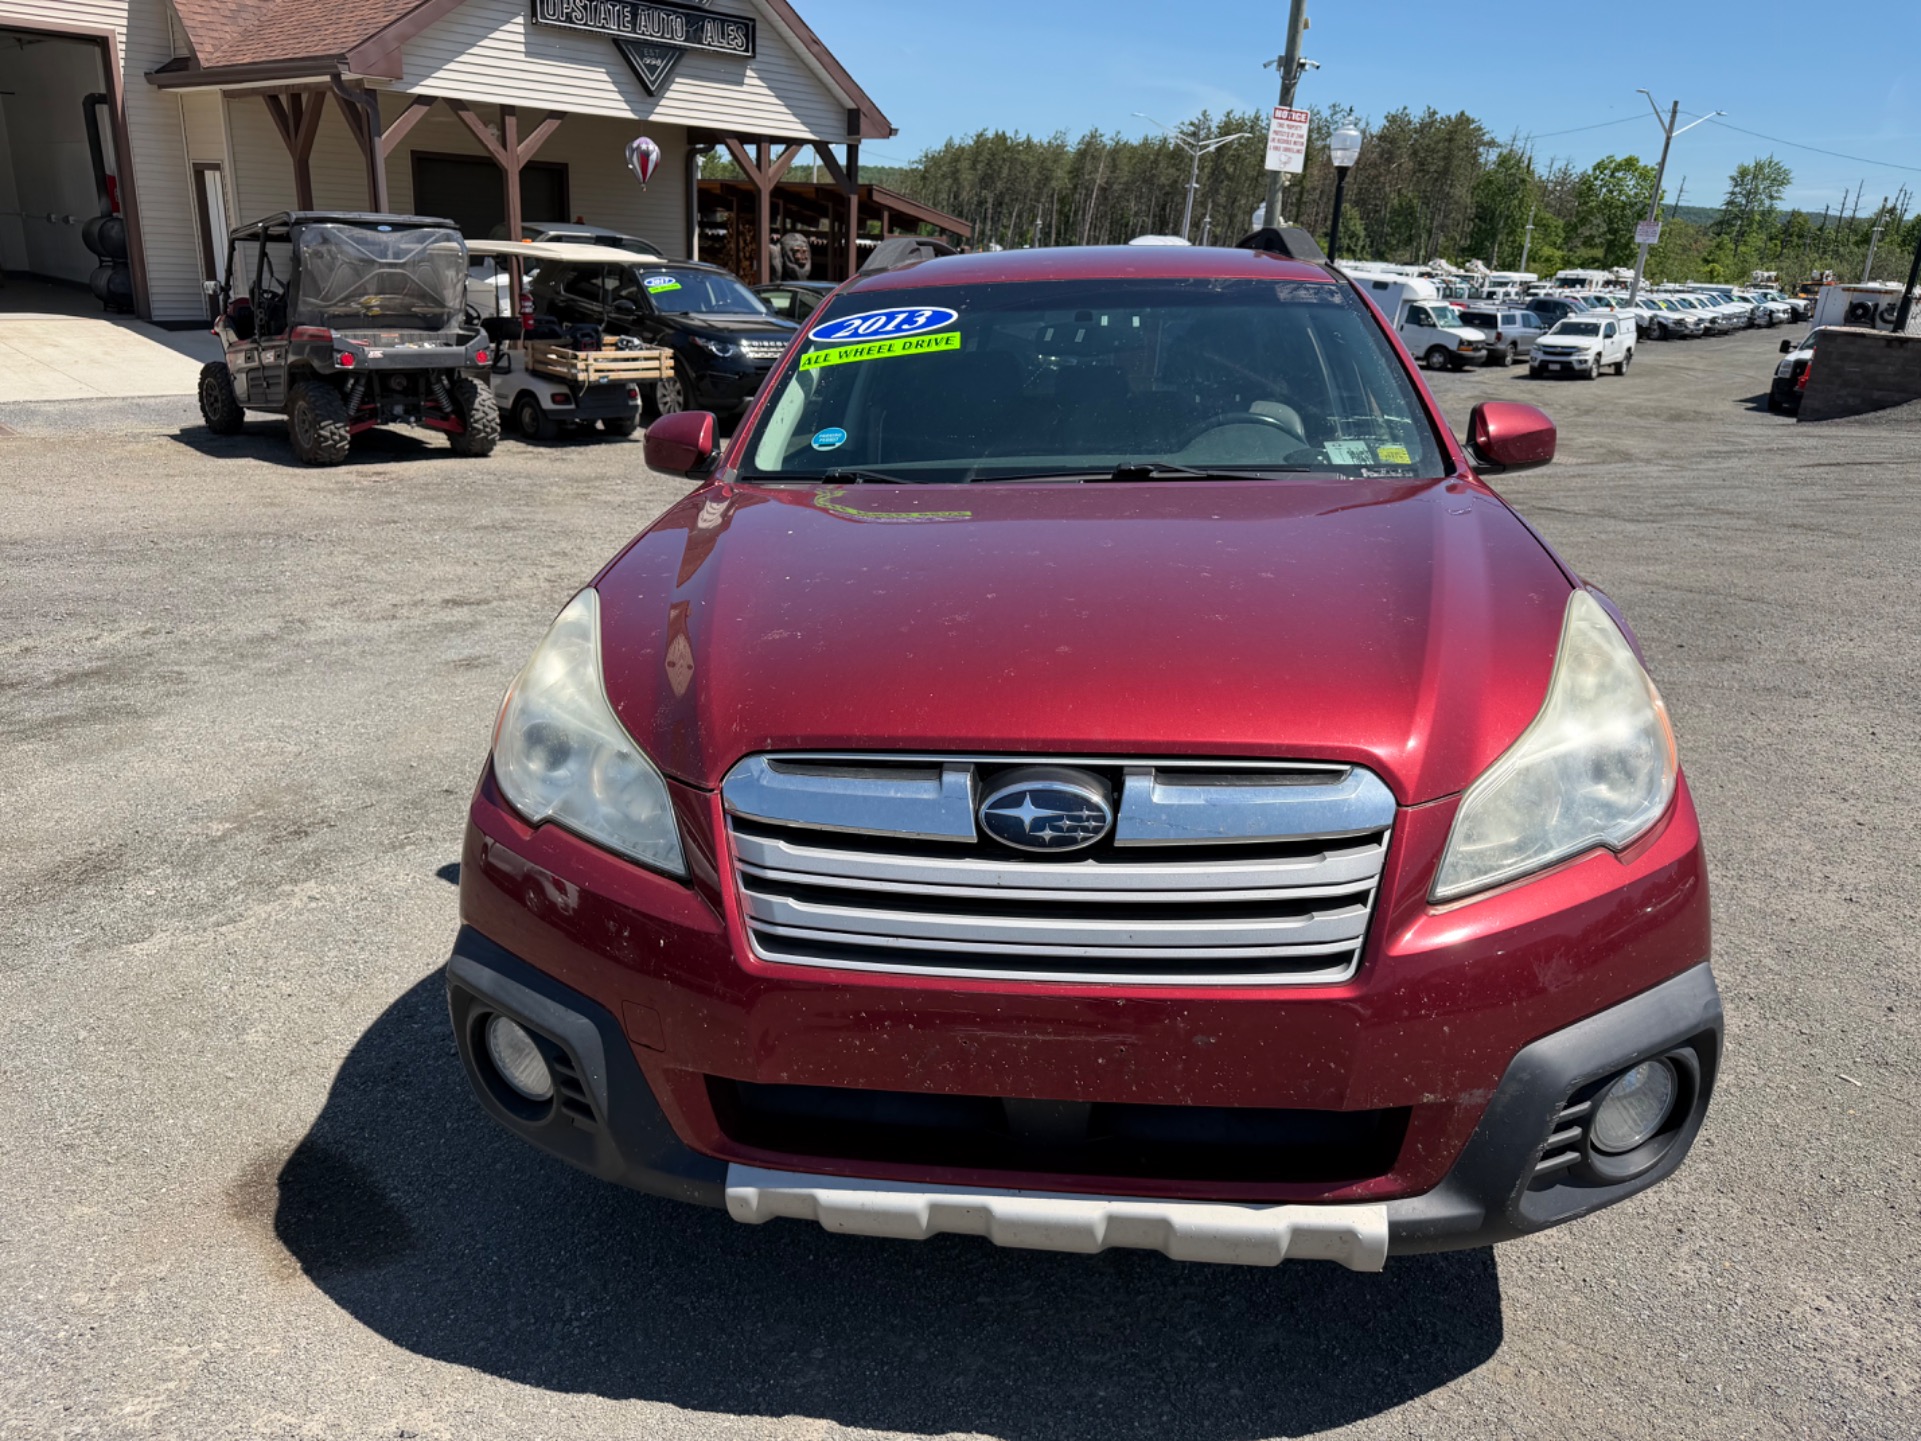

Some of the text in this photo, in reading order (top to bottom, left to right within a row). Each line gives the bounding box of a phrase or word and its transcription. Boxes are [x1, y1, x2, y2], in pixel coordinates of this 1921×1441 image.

[545, 0, 746, 50] UPSTATE AUTO ALES
[1274, 109, 1307, 121] NOTICE
[831, 310, 933, 338] 2013
[801, 335, 957, 367] ALL WHEEL DRIVE
